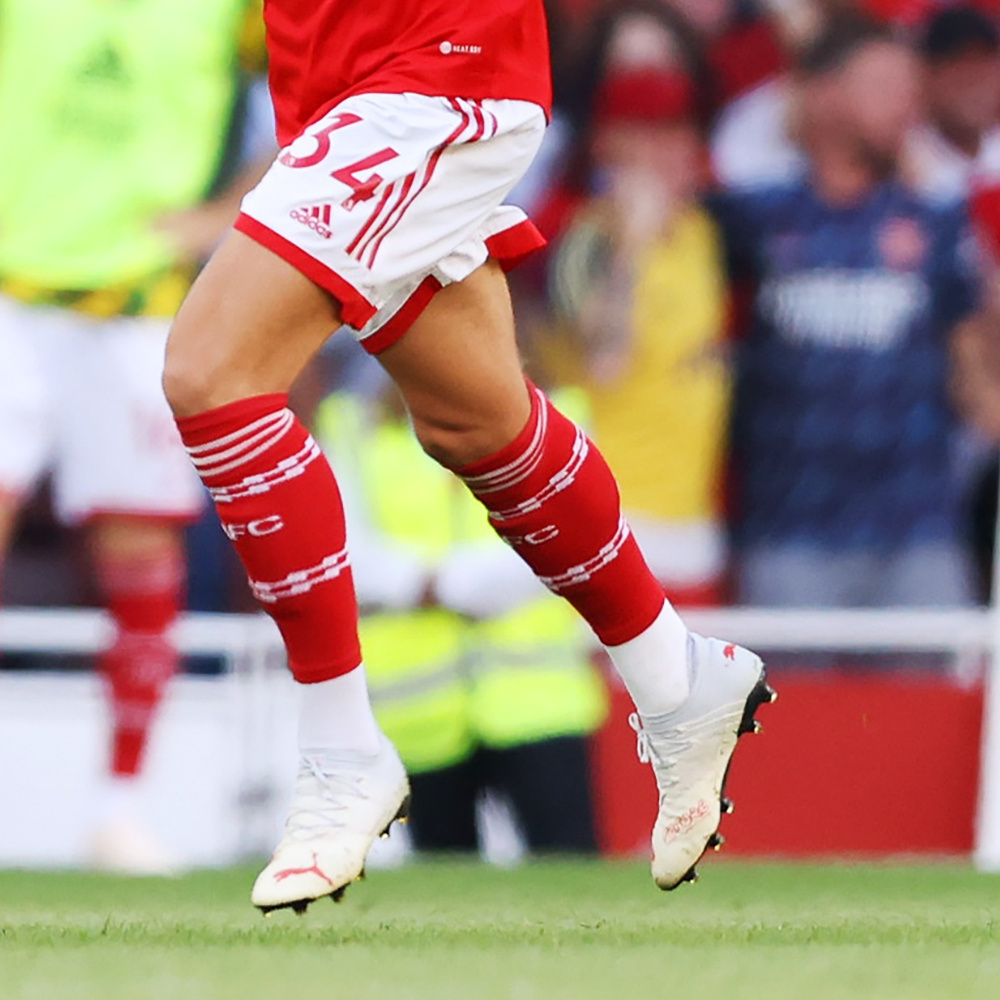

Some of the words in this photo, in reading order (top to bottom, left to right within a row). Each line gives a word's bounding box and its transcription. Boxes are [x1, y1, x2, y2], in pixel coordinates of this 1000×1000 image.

[279, 112, 399, 212] 34
[289, 210, 332, 239] adidas
[221, 515, 284, 540] FC
